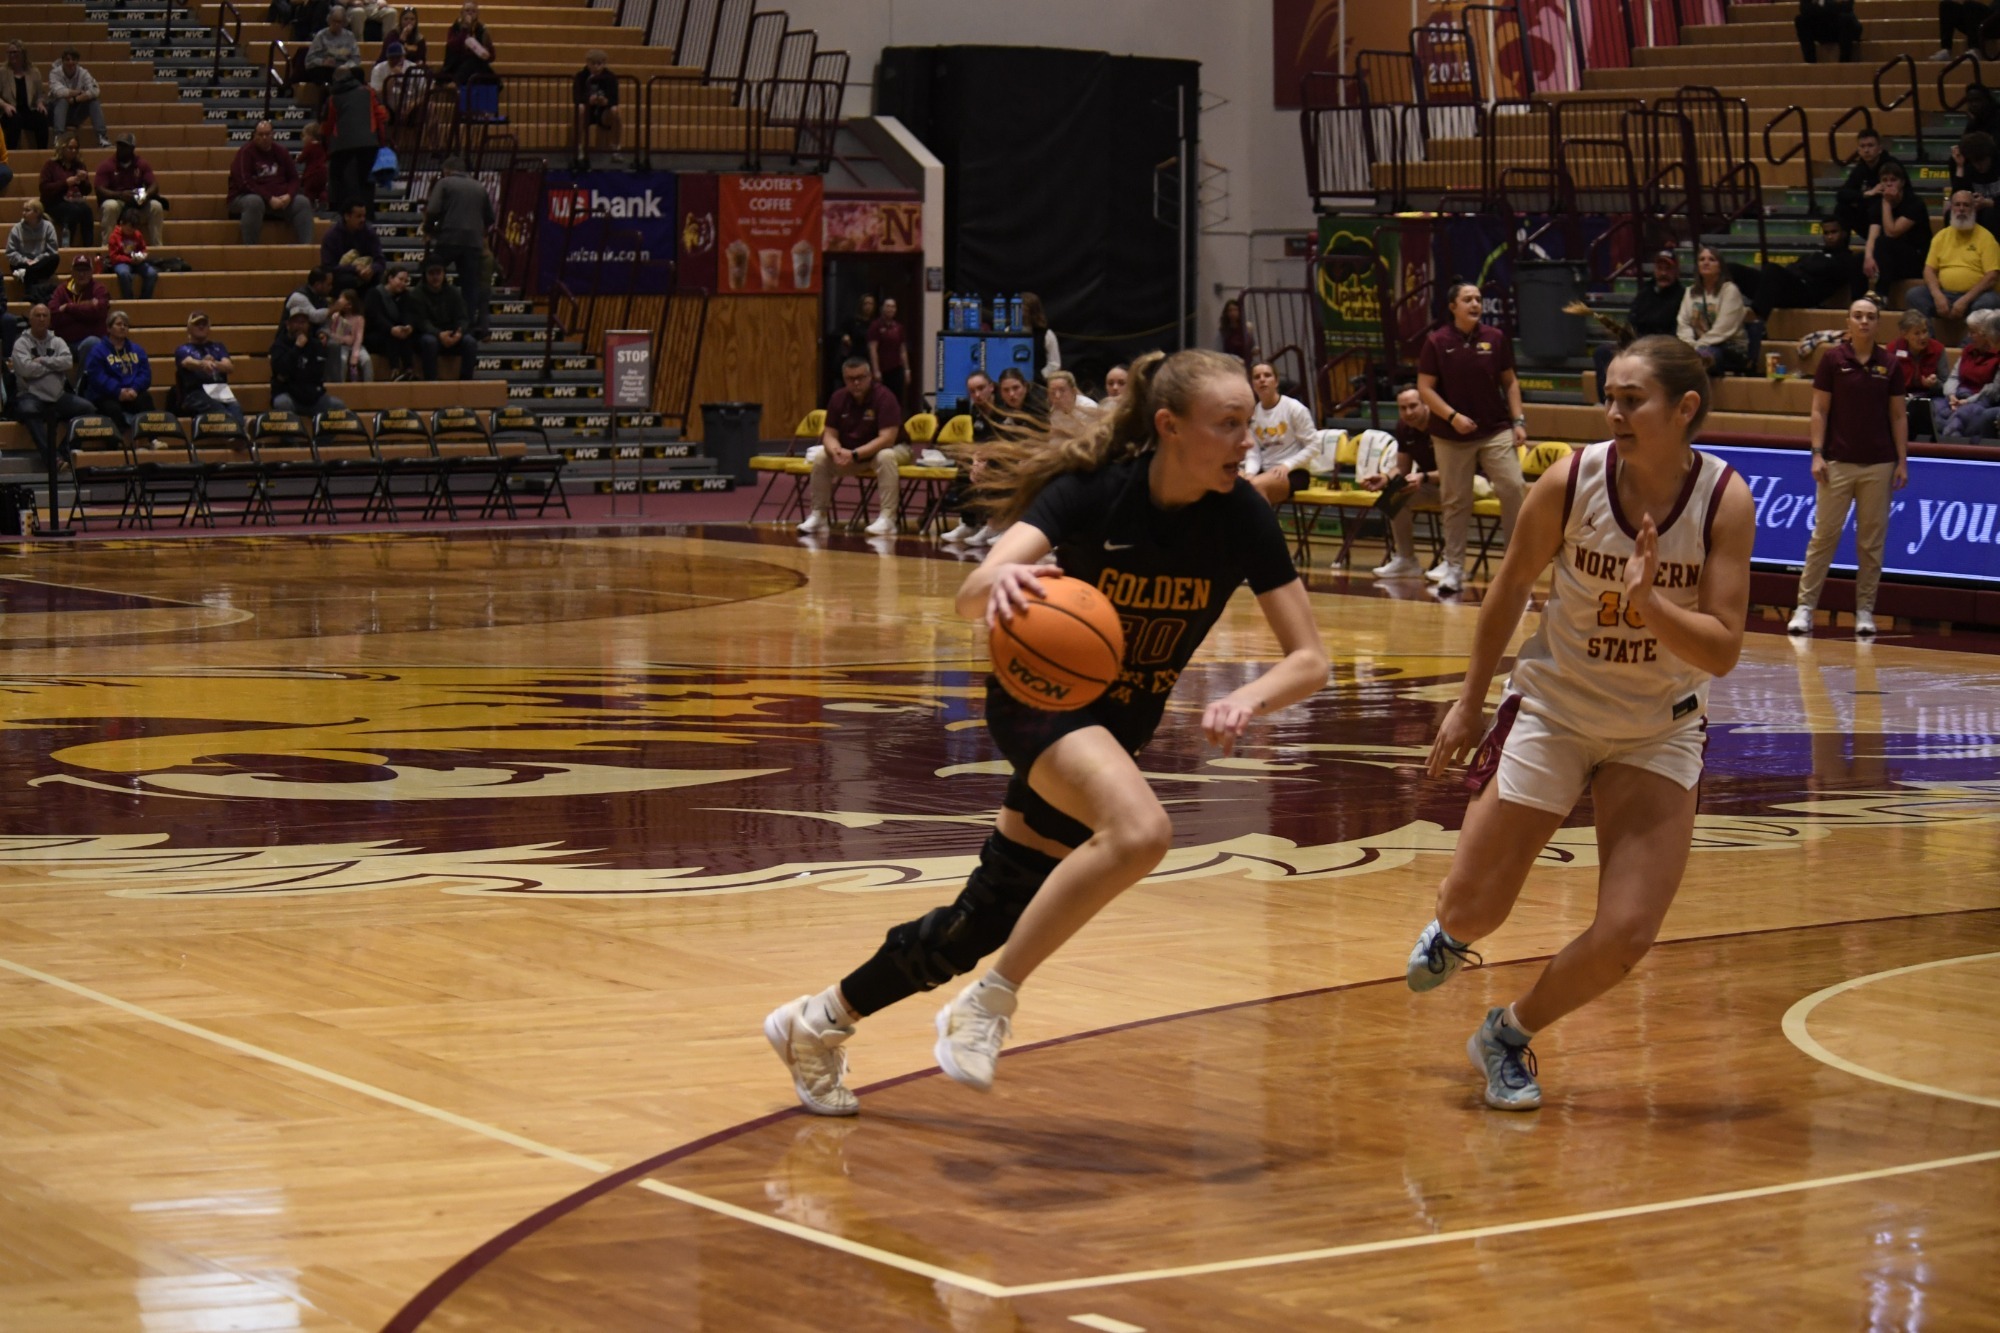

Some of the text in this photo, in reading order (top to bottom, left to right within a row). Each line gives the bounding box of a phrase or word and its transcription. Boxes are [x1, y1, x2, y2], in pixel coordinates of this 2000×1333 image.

[232, 132, 252, 140] NVC
[739, 177, 803, 191] SCOOTER'S
[389, 203, 410, 212] NVC
[591, 189, 662, 218] bank
[749, 198, 792, 211] COFFEE
[376, 228, 396, 236] NVC
[882, 208, 917, 246] N
[403, 252, 424, 260] NVC
[503, 304, 525, 313] NVC
[491, 331, 513, 340] NVC
[617, 350, 649, 363] STOP
[478, 360, 588, 369] NVC NVC NVC
[510, 387, 577, 396] NVC NVC
[542, 417, 566, 426] NVC
[587, 417, 610, 426] NVC
[575, 449, 599, 458] NVC
[665, 446, 688, 456] NVC
[614, 479, 727, 491] NVC NVC NVC
[1575, 545, 1700, 588] NORTERN
[1098, 567, 1211, 611] GOLDEN
[1588, 637, 1657, 663] STATE
[1008, 656, 1071, 700] NCAA
